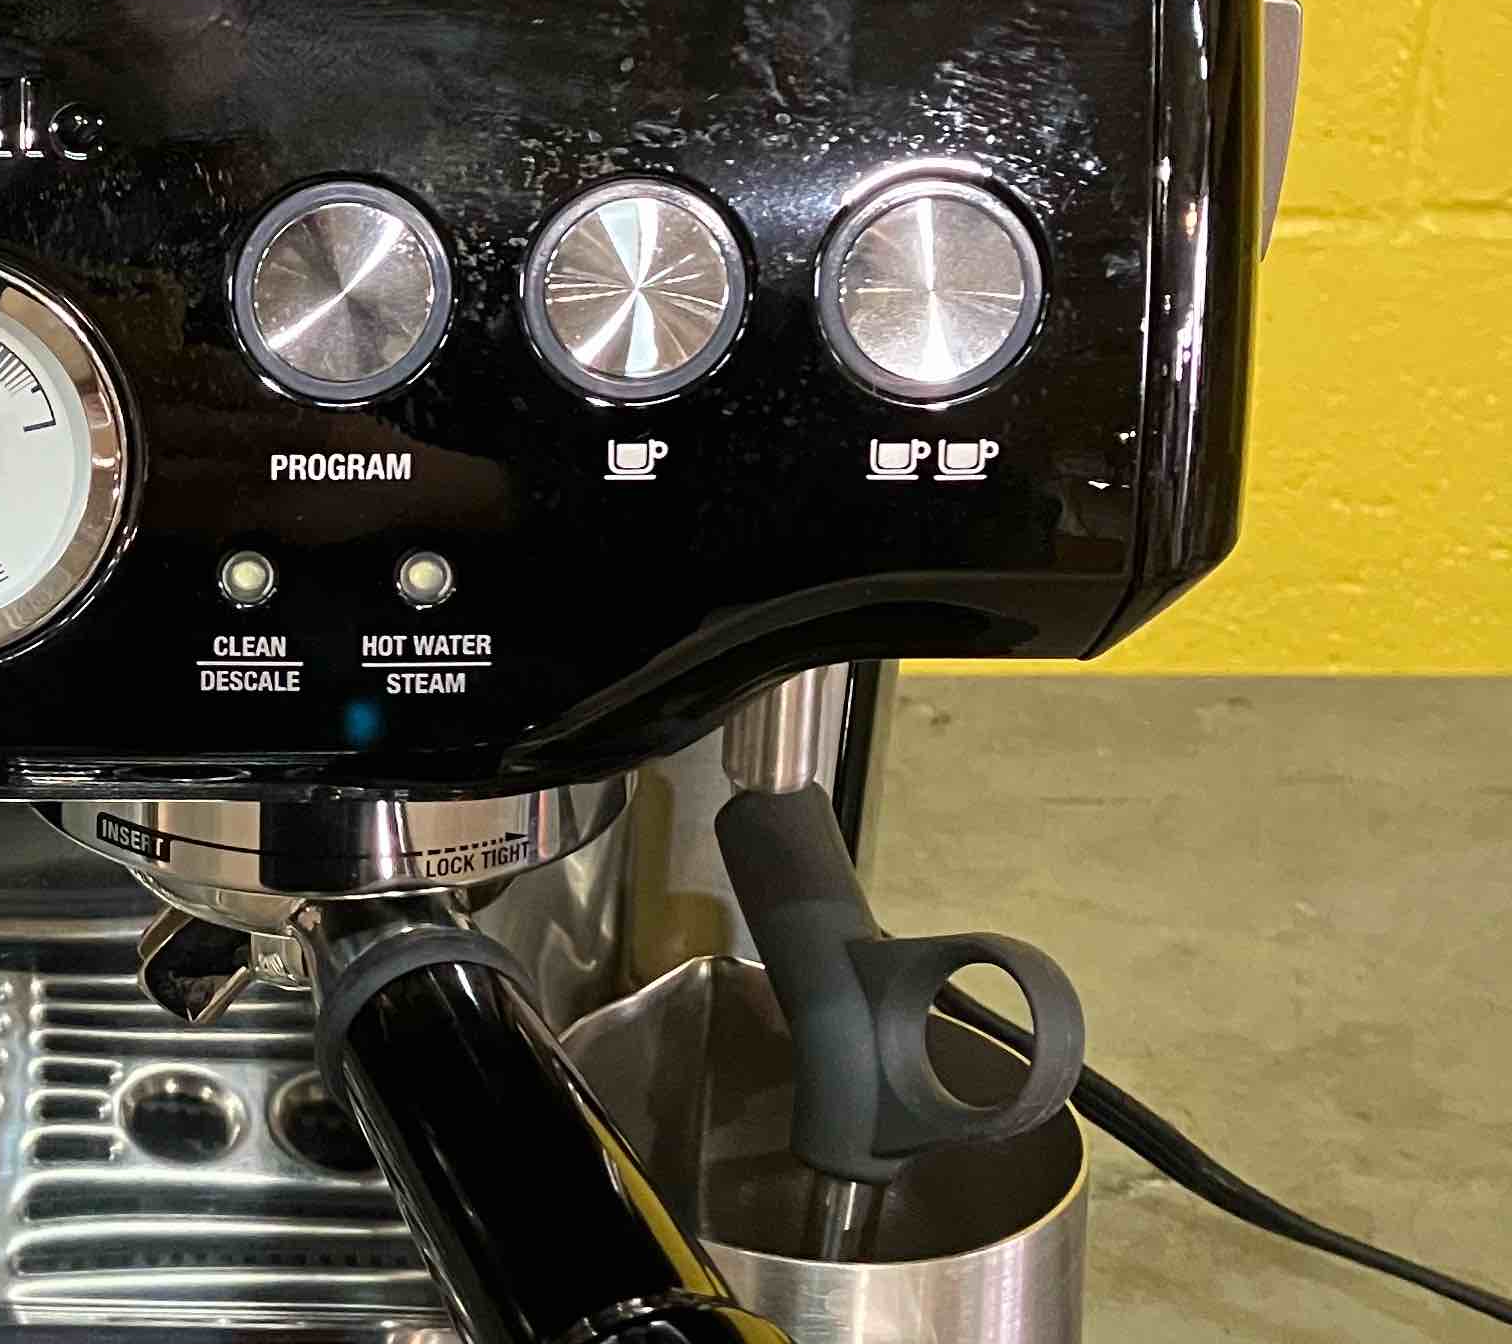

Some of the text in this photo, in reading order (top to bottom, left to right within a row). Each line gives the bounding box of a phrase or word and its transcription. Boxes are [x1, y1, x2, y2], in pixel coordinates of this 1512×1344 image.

[270, 454, 412, 482] PROGRAM
[213, 636, 287, 658] CLEAN
[362, 634, 492, 657] HOT WATER
[200, 671, 301, 693] DESCALE
[386, 674, 466, 695] STEAM
[102, 819, 165, 856] INSERT
[425, 841, 529, 878] LOCK TIGHT
